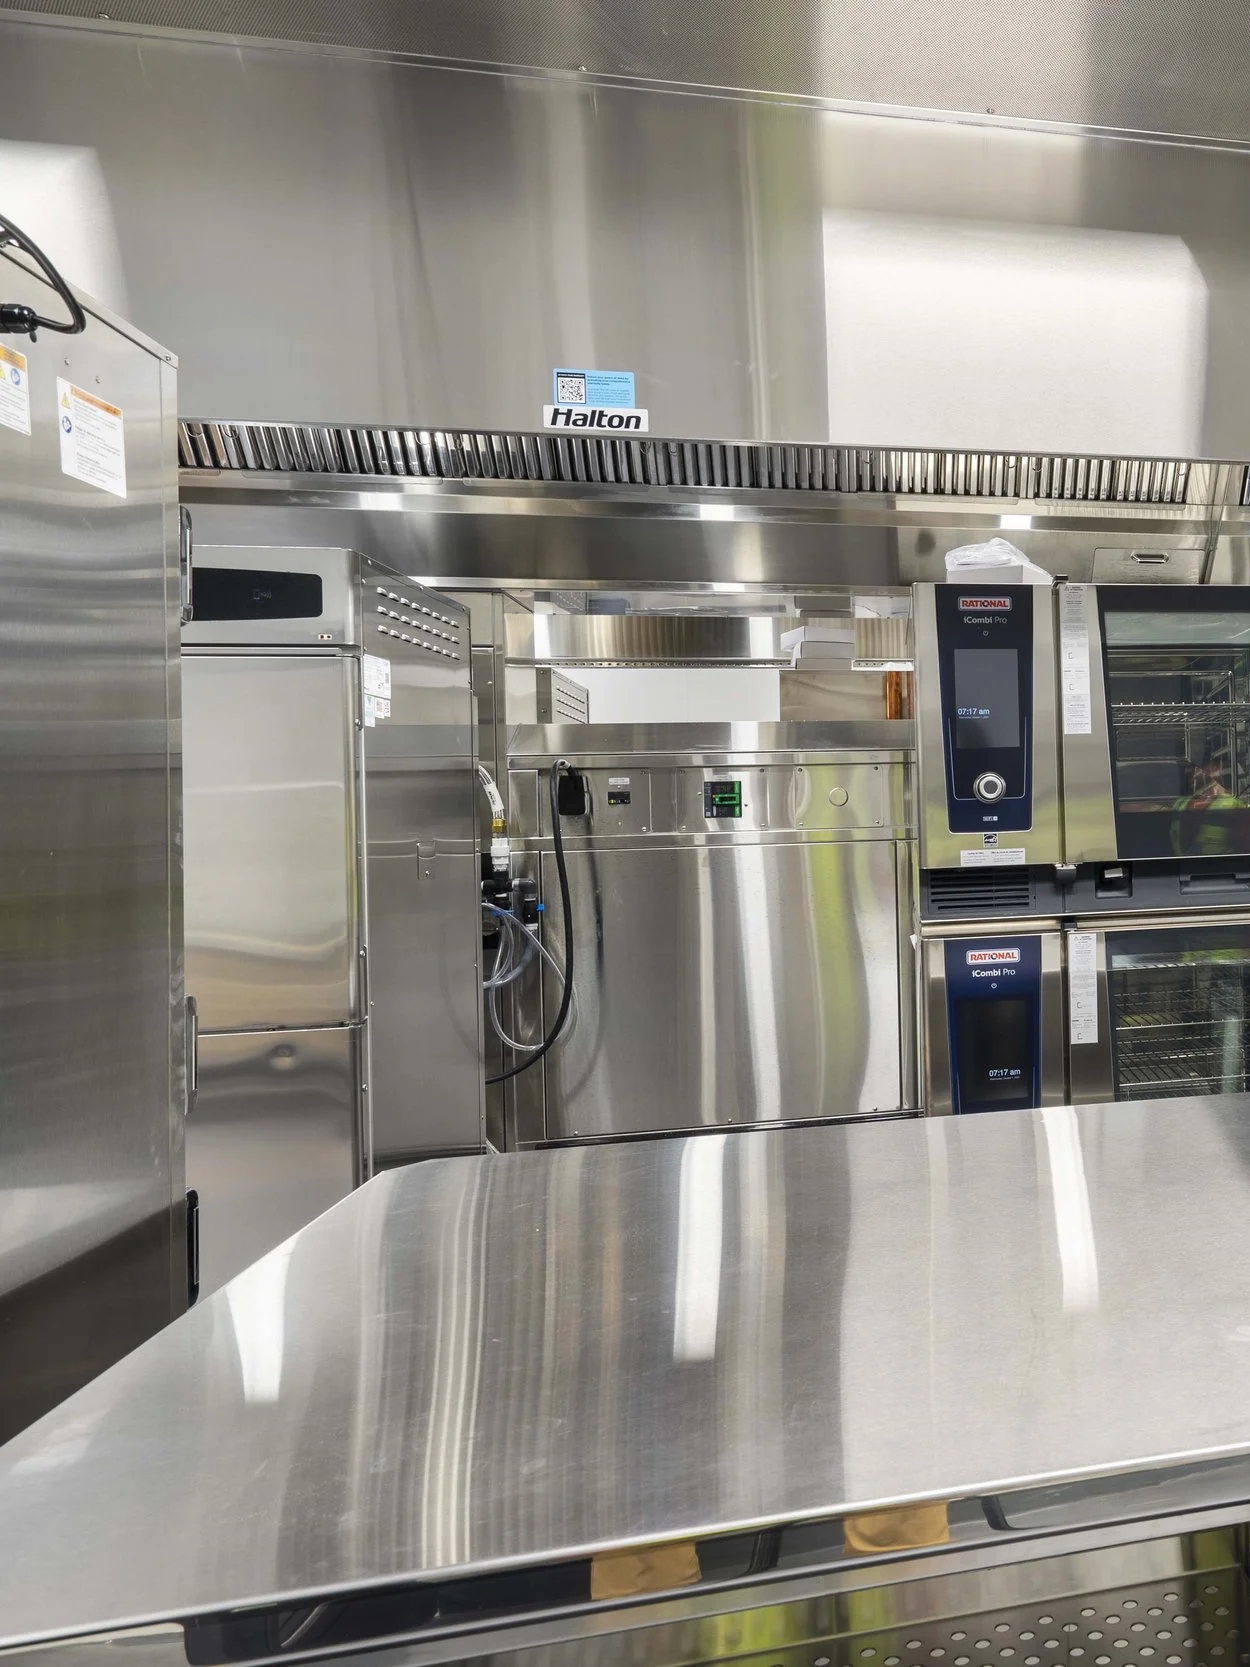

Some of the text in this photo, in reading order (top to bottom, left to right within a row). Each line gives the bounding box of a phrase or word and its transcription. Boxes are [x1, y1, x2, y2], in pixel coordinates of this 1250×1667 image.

[550, 407, 642, 430] Halton
[961, 600, 1008, 608] RATIONAL
[963, 616, 1008, 624] iCombi Pro
[957, 707, 978, 715] 07:17
[970, 951, 1017, 961] RATIONAL
[971, 968, 1016, 978] iCombi Pro
[989, 1068, 1009, 1077] 07:17
